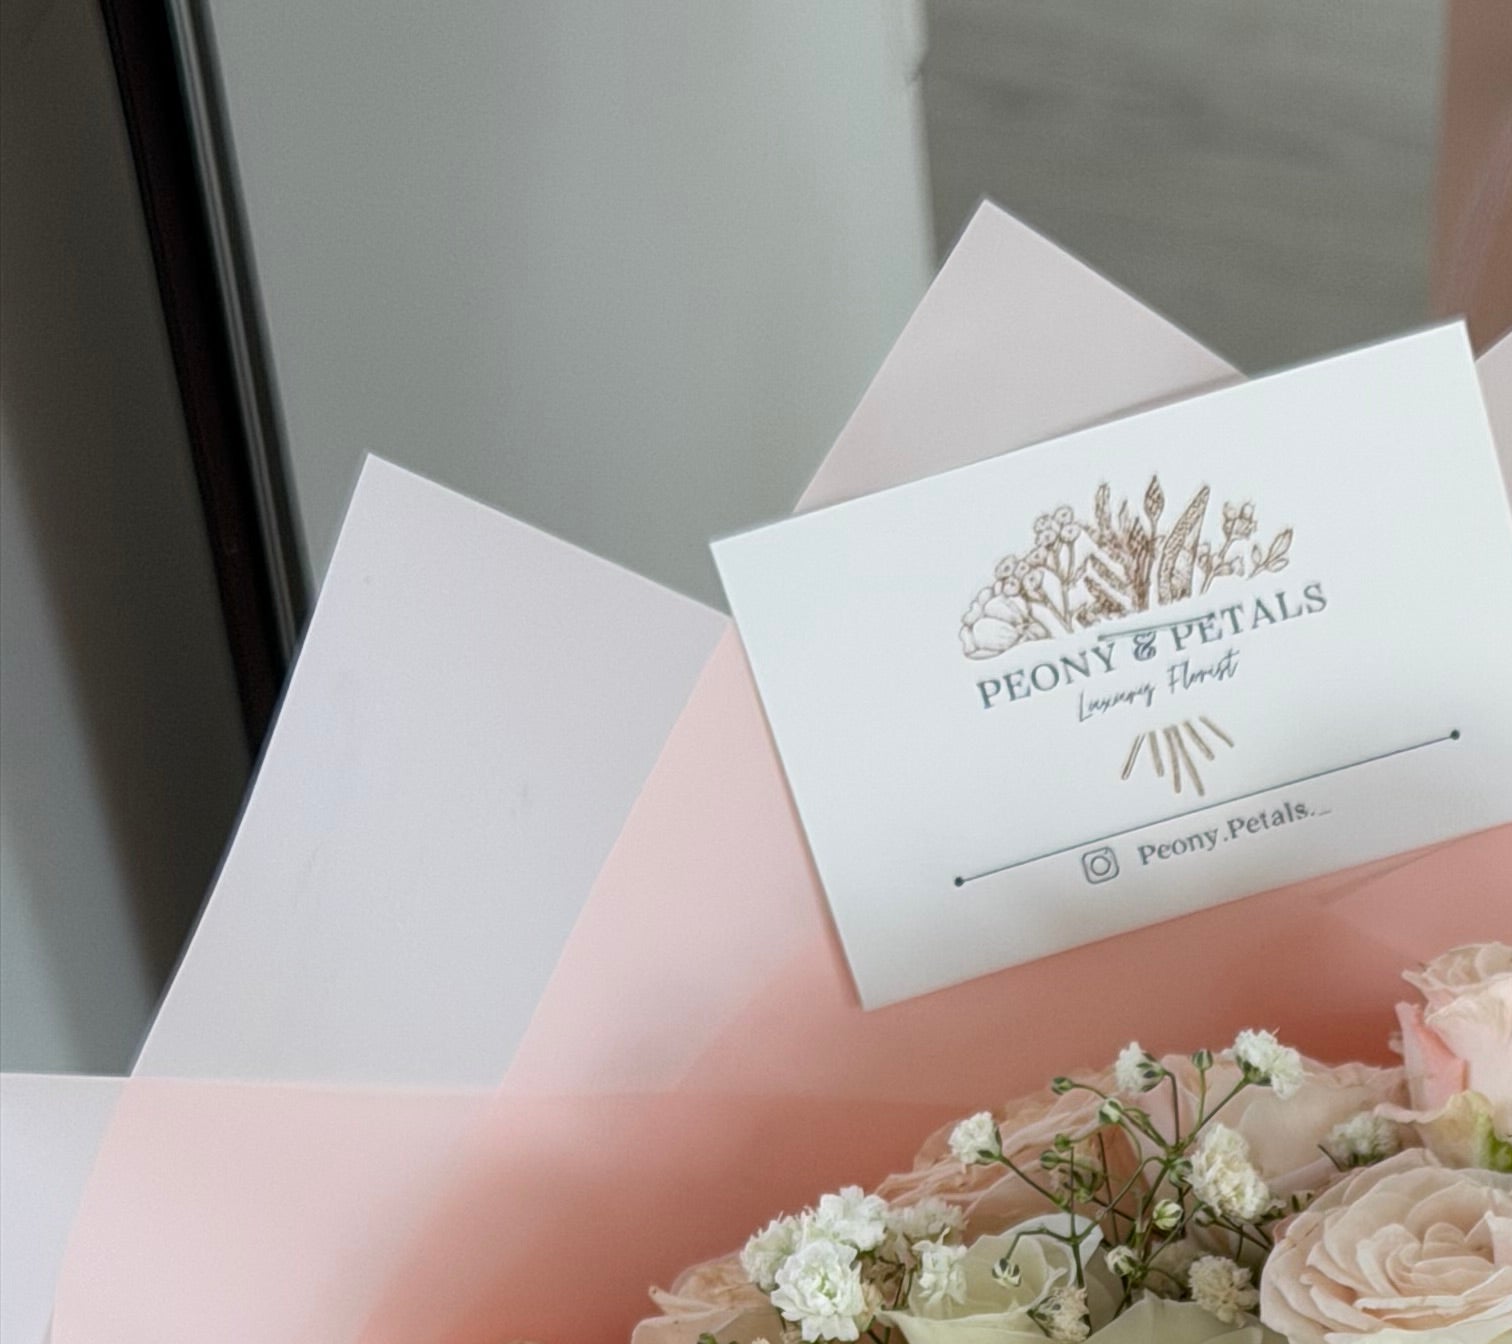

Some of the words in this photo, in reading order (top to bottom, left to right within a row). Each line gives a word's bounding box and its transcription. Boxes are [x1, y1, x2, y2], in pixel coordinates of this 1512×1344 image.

[976, 643, 1117, 709] PEONY
[1133, 631, 1157, 661] &
[1171, 583, 1328, 651] PETALS
[1079, 683, 1156, 722] Luxury
[1167, 649, 1241, 693] Florist
